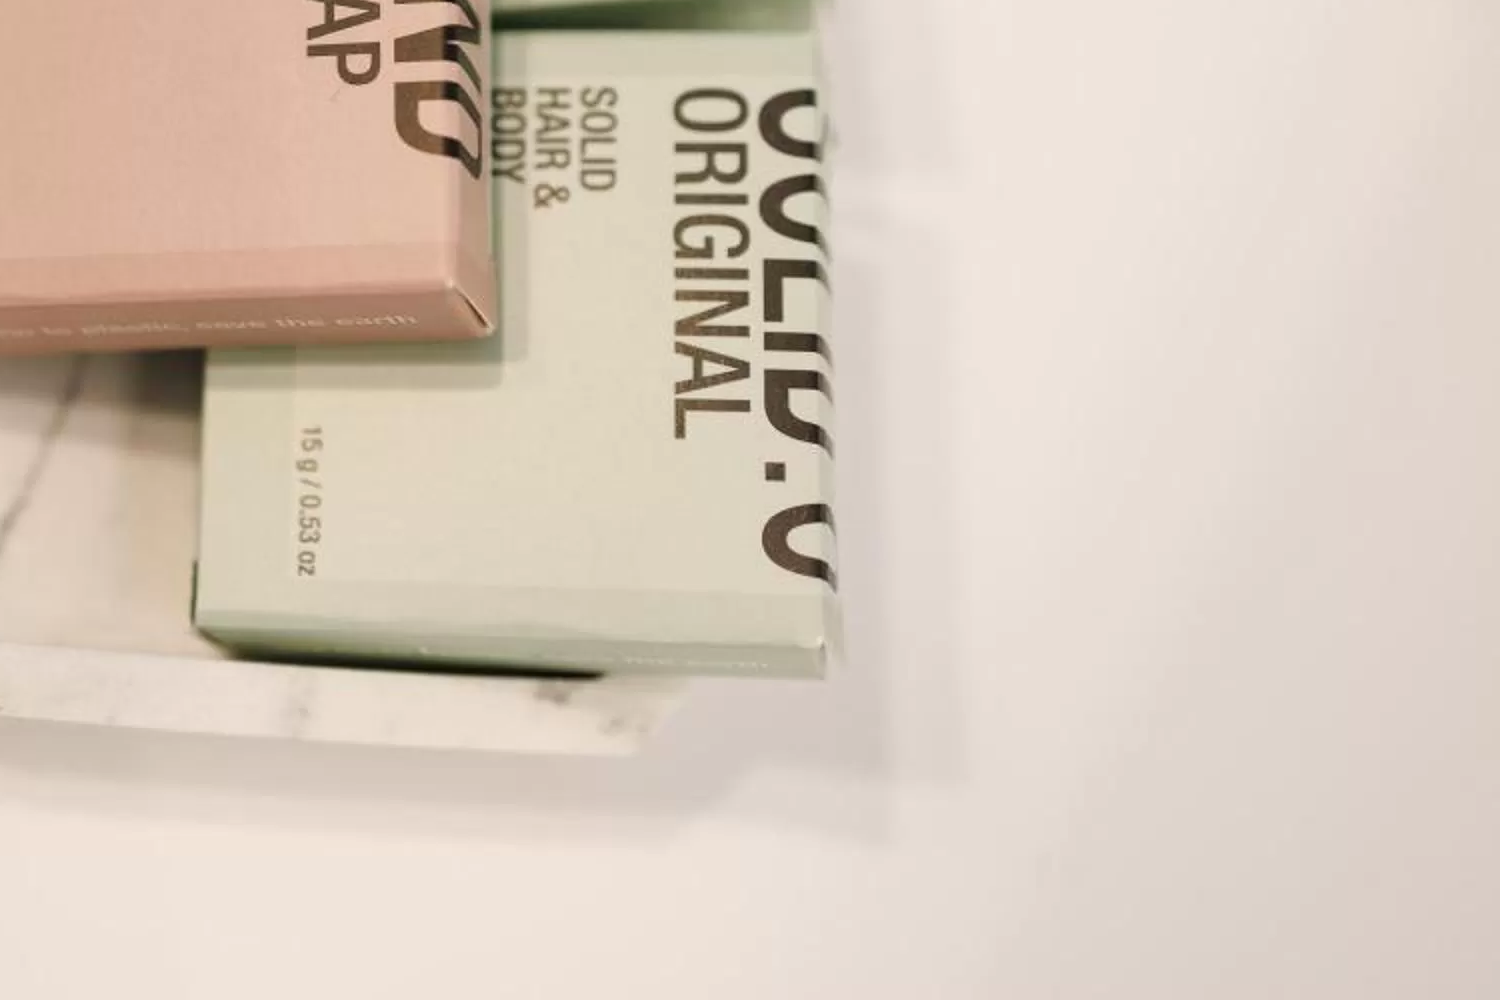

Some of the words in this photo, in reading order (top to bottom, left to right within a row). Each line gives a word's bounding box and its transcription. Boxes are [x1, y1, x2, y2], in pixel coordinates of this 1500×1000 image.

[491, 86, 528, 185] BODY
[533, 86, 573, 171] HAIR
[579, 85, 618, 192] SOLID
[533, 181, 571, 210] &
[672, 87, 751, 440] ORIGINAL
[299, 425, 324, 453] 15
[295, 458, 319, 474] g
[299, 476, 323, 490] /
[298, 493, 323, 544] 0.53
[296, 549, 317, 578] oz
